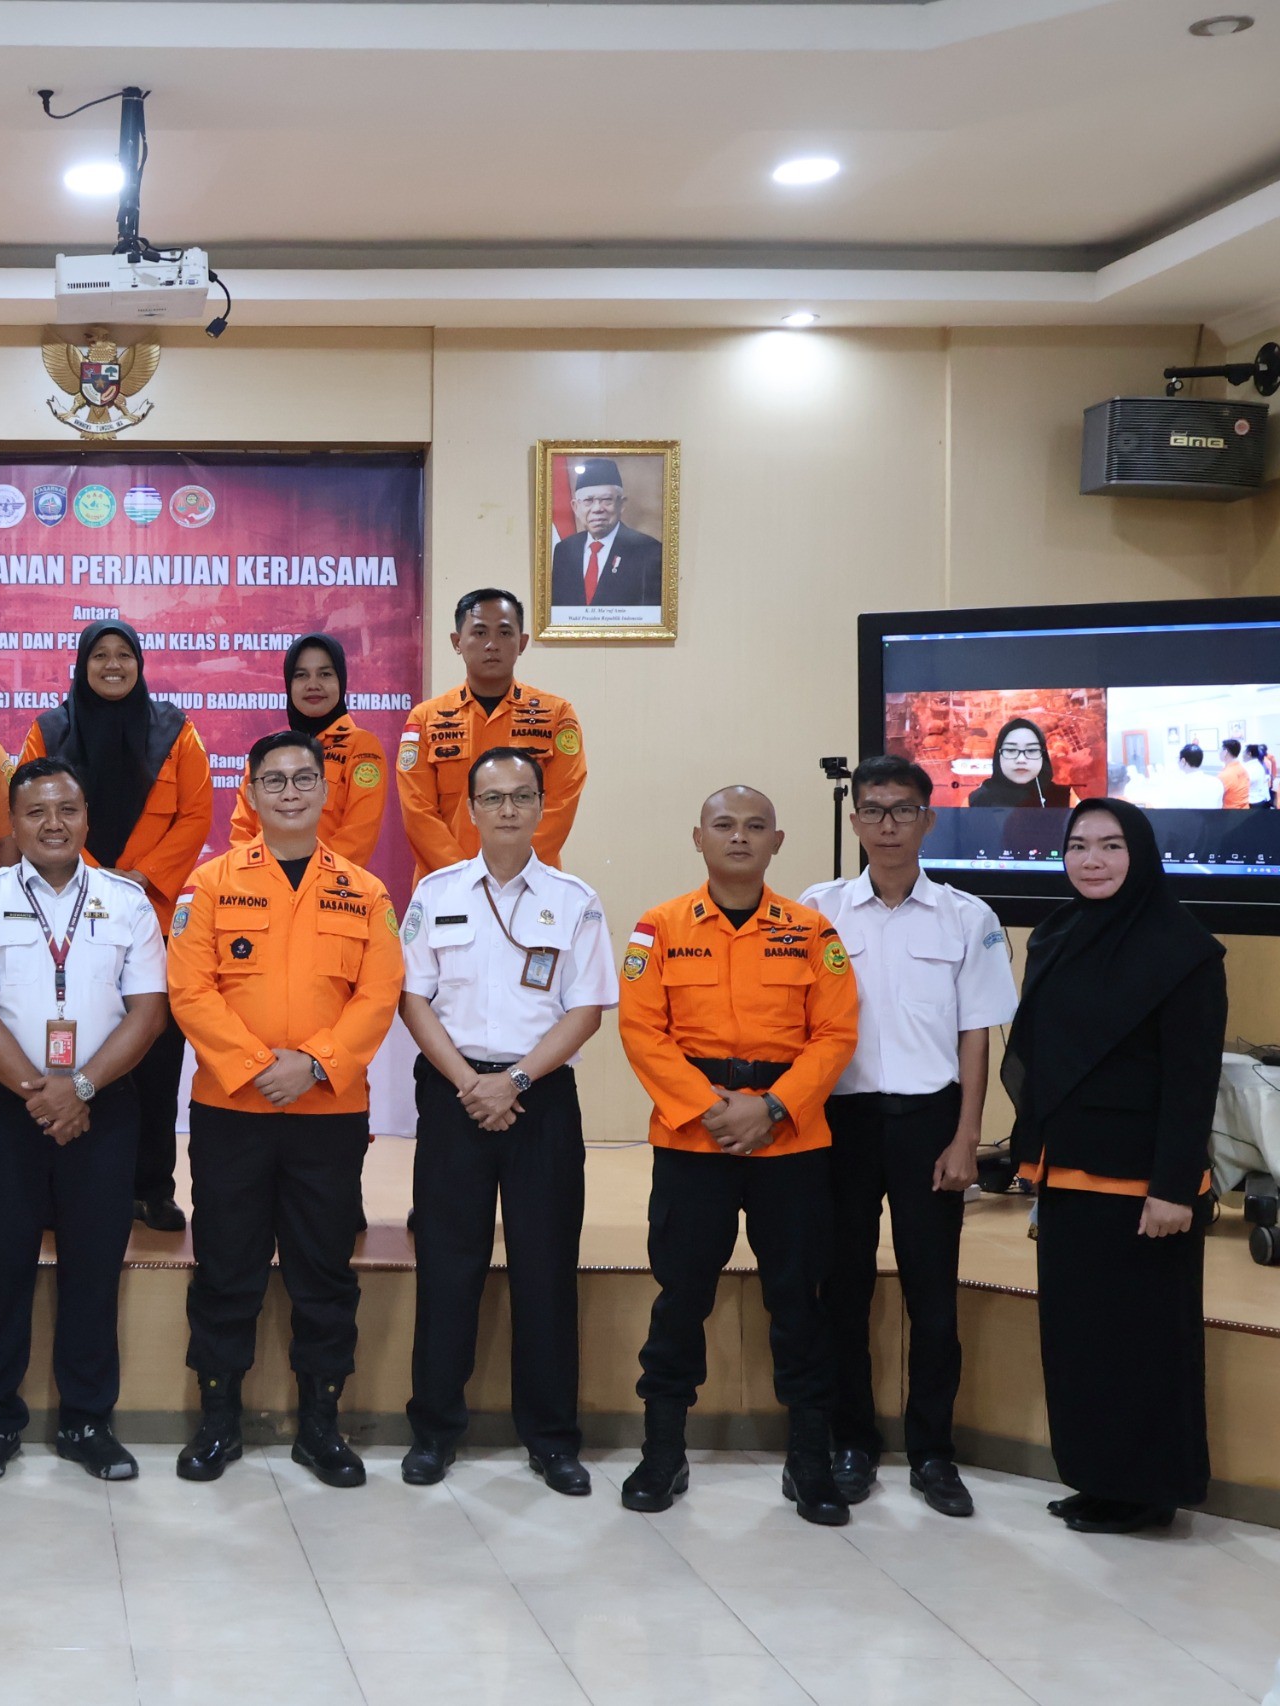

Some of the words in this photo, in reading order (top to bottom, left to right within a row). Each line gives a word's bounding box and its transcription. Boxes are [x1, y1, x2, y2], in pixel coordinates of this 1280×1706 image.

[72, 555, 230, 585] PERJANJIAN
[236, 556, 398, 586] KERJASAMA
[73, 605, 119, 621] Antara
[22, 632, 54, 650] DAN
[169, 633, 216, 650] KELAS
[220, 634, 230, 650] B
[13, 692, 59, 709] KELAS
[206, 693, 287, 710] BADARUDD
[431, 731, 465, 741] DONNY
[512, 729, 552, 739] BASARNAS
[219, 895, 268, 908] RAYMOND
[320, 900, 366, 916] BASARNAS
[668, 947, 712, 958] MANCA
